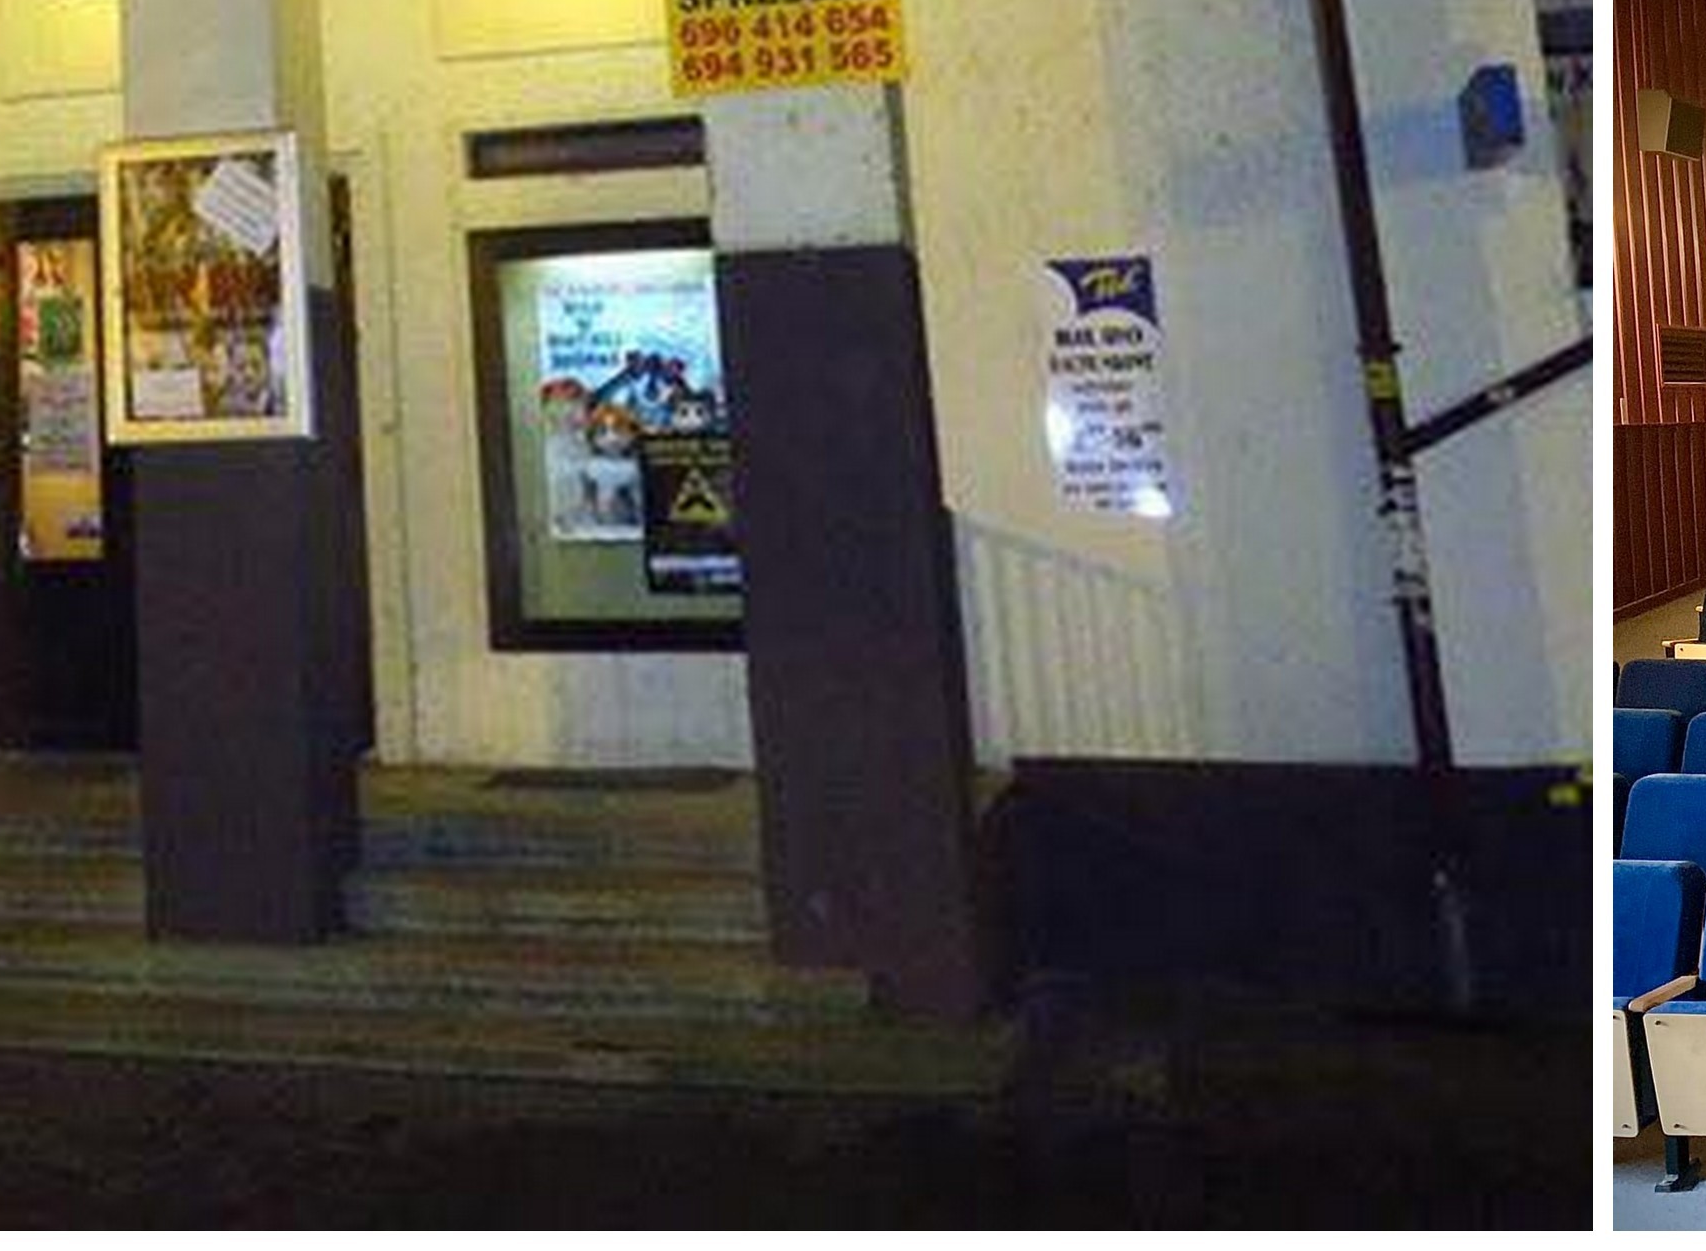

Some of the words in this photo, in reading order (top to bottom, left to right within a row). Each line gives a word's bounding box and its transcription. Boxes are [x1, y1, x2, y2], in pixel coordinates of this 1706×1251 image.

[680, 17, 742, 49] 696
[751, 10, 816, 39] 414
[825, 5, 889, 36] 654
[681, 51, 744, 82] 694
[754, 45, 816, 78] 931
[828, 38, 894, 70] 565
